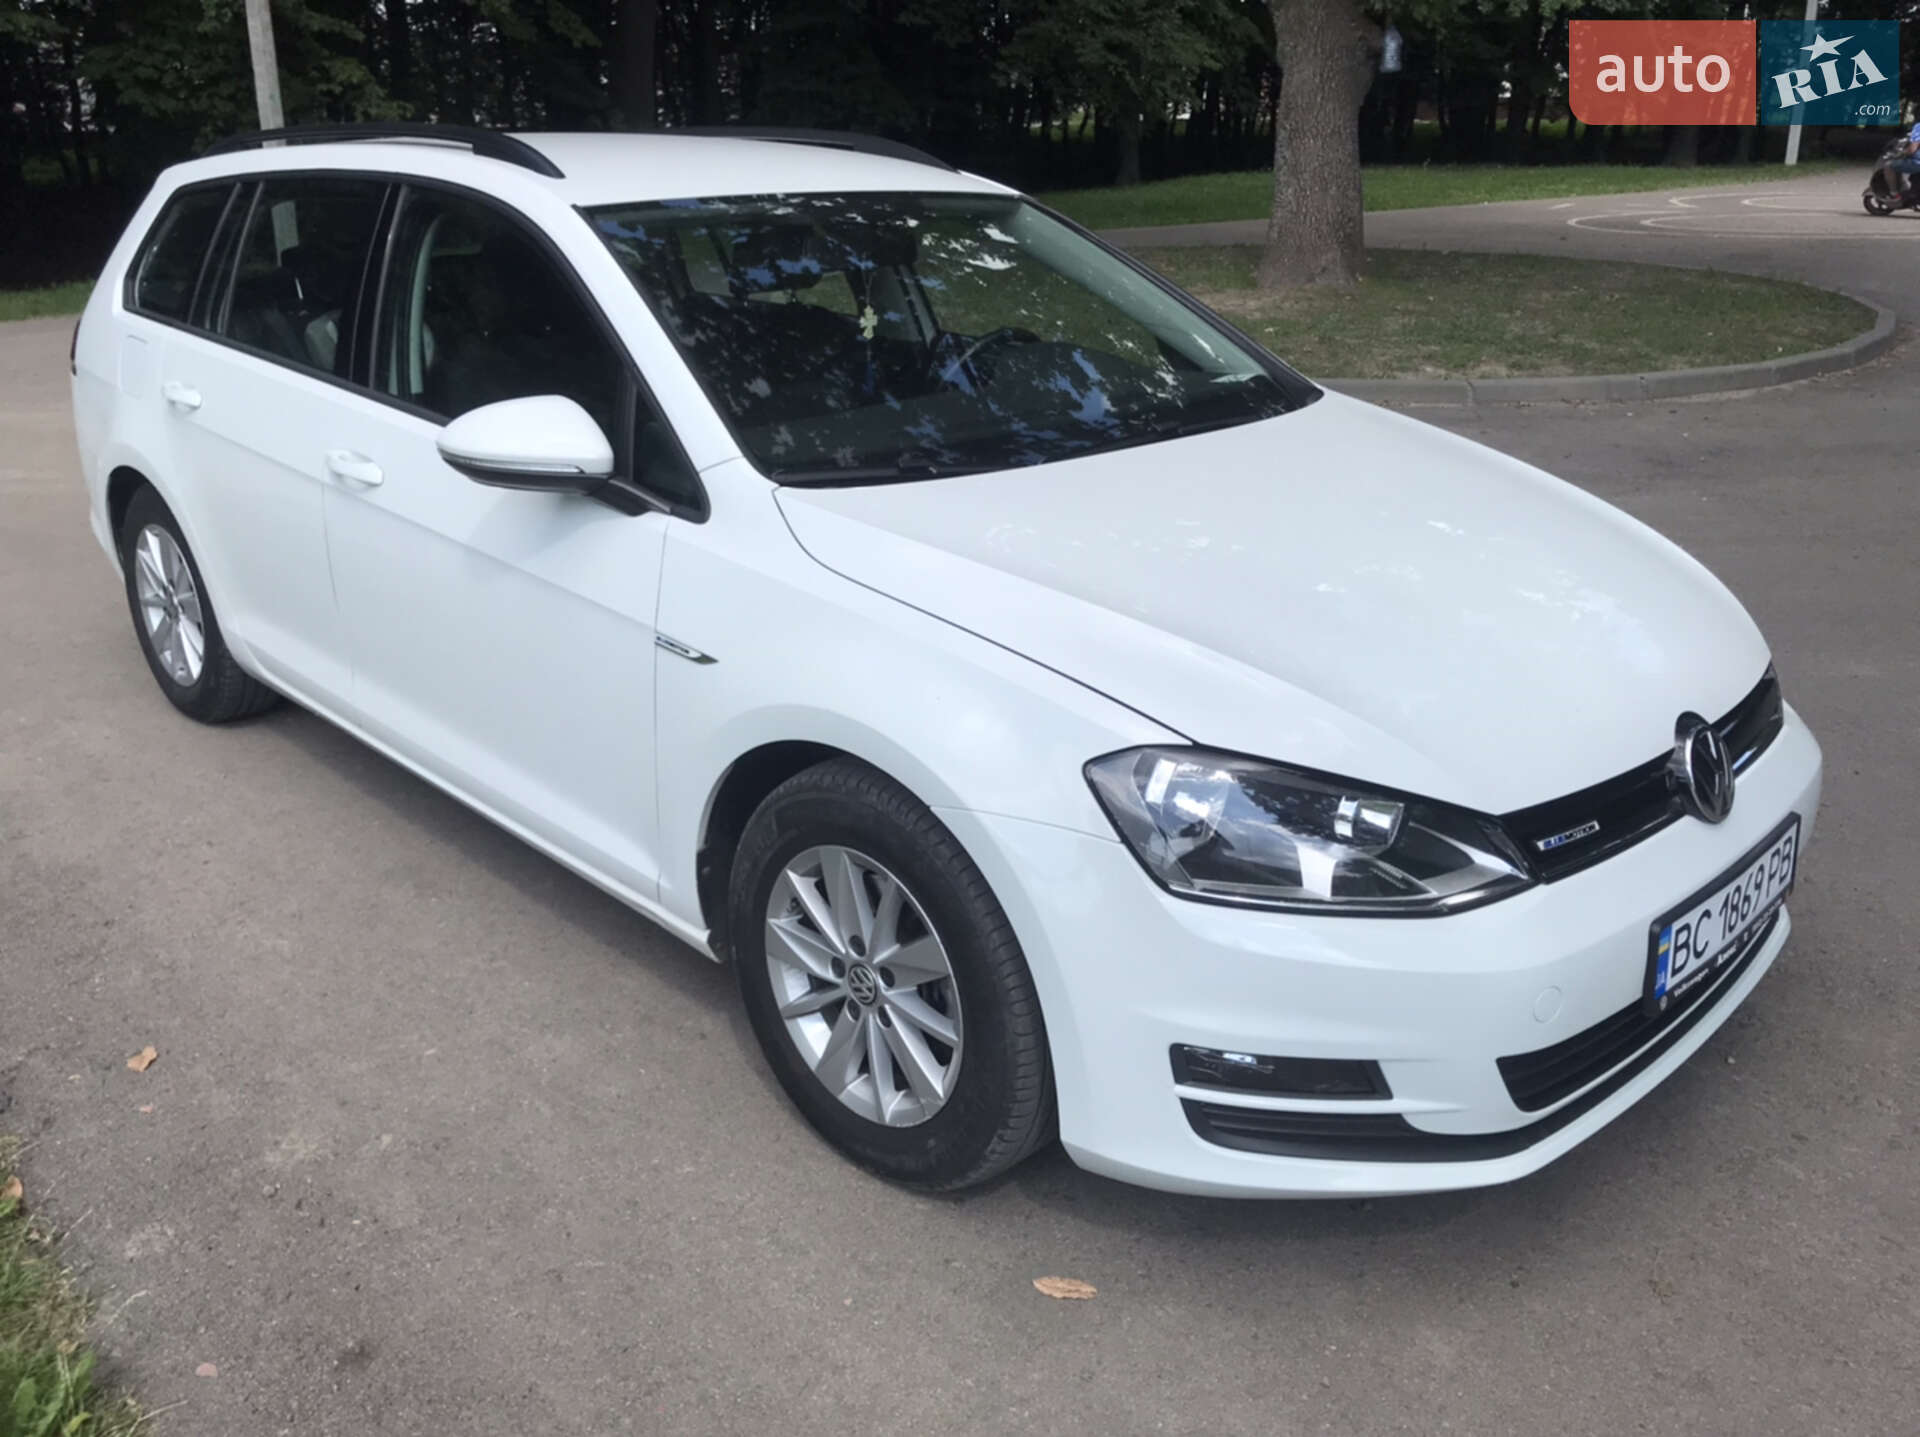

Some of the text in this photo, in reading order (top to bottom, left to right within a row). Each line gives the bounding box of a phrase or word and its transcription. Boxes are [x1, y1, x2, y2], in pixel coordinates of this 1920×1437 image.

[1671, 908, 1712, 978] BC
[1719, 864, 1764, 940] 1869
[1766, 836, 1793, 898] PB
